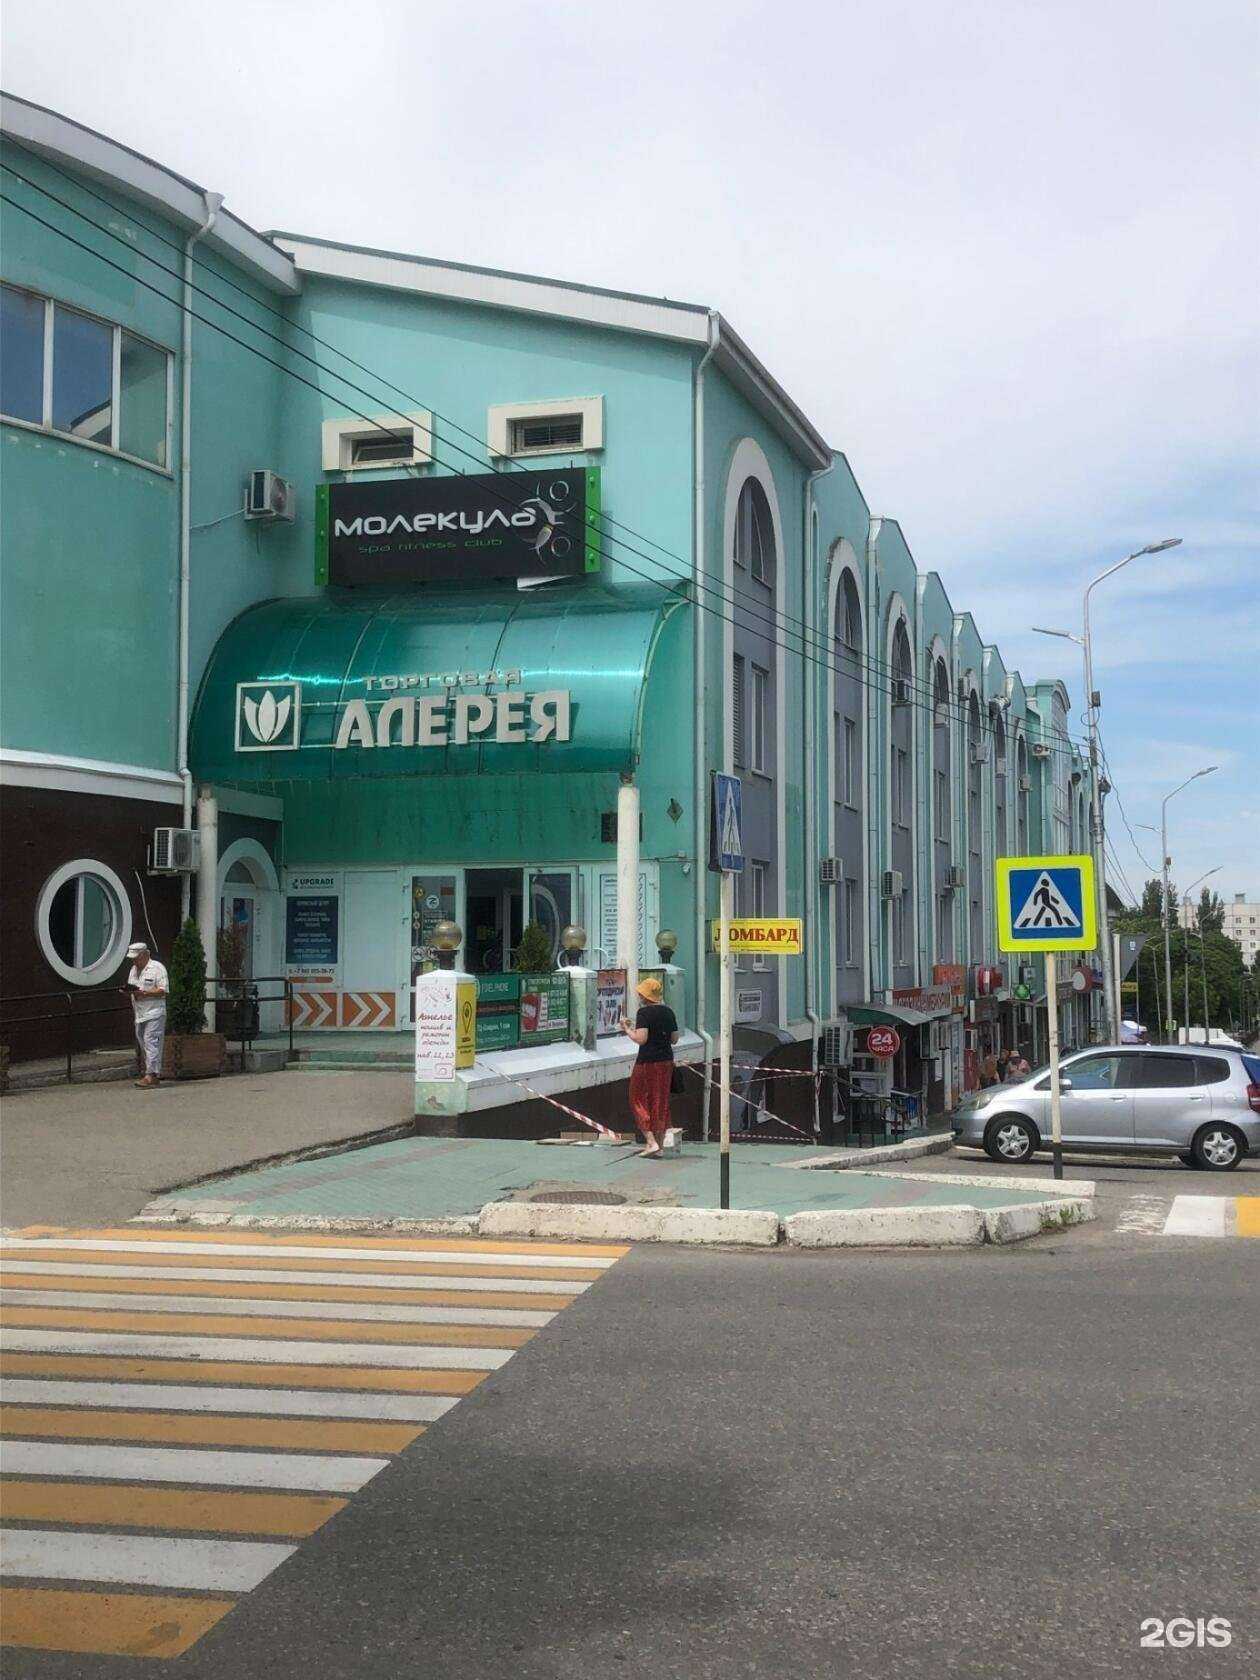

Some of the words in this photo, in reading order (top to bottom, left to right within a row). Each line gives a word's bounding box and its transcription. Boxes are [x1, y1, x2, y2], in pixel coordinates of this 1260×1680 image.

[366, 668, 522, 691] ТОРГОВАЯ
[335, 689, 571, 749] АЛЕРЕЯ
[871, 1033, 893, 1045] 24
